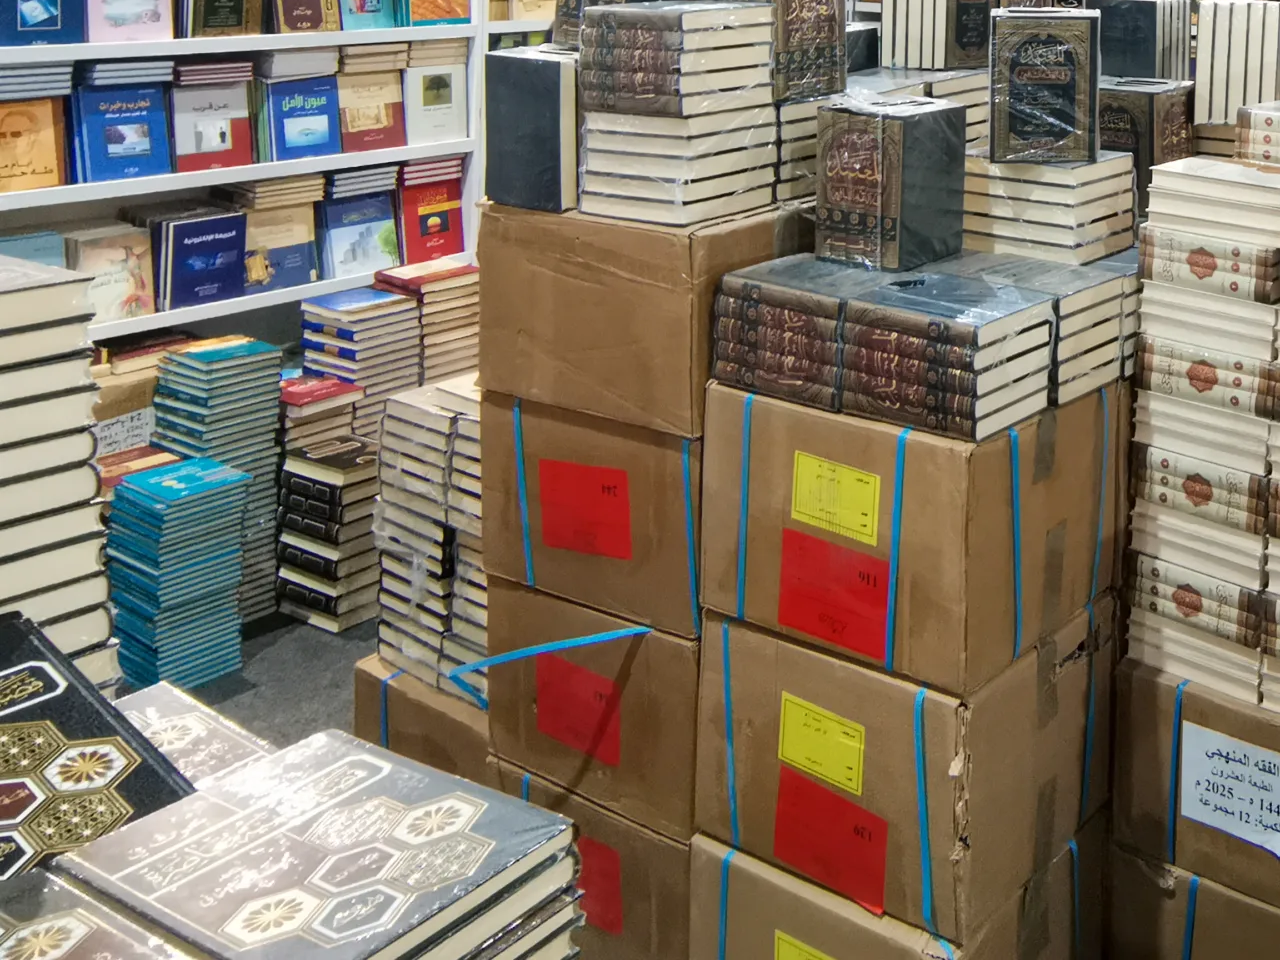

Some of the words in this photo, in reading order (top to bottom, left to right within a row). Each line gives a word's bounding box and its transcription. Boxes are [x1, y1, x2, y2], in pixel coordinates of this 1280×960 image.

[1205, 748, 1250, 768] المنهجي
[1254, 760, 1280, 777] الفقه
[1204, 779, 1234, 800] 2025
[1248, 775, 1273, 793] الطبعة
[1239, 810, 1251, 824] 12
